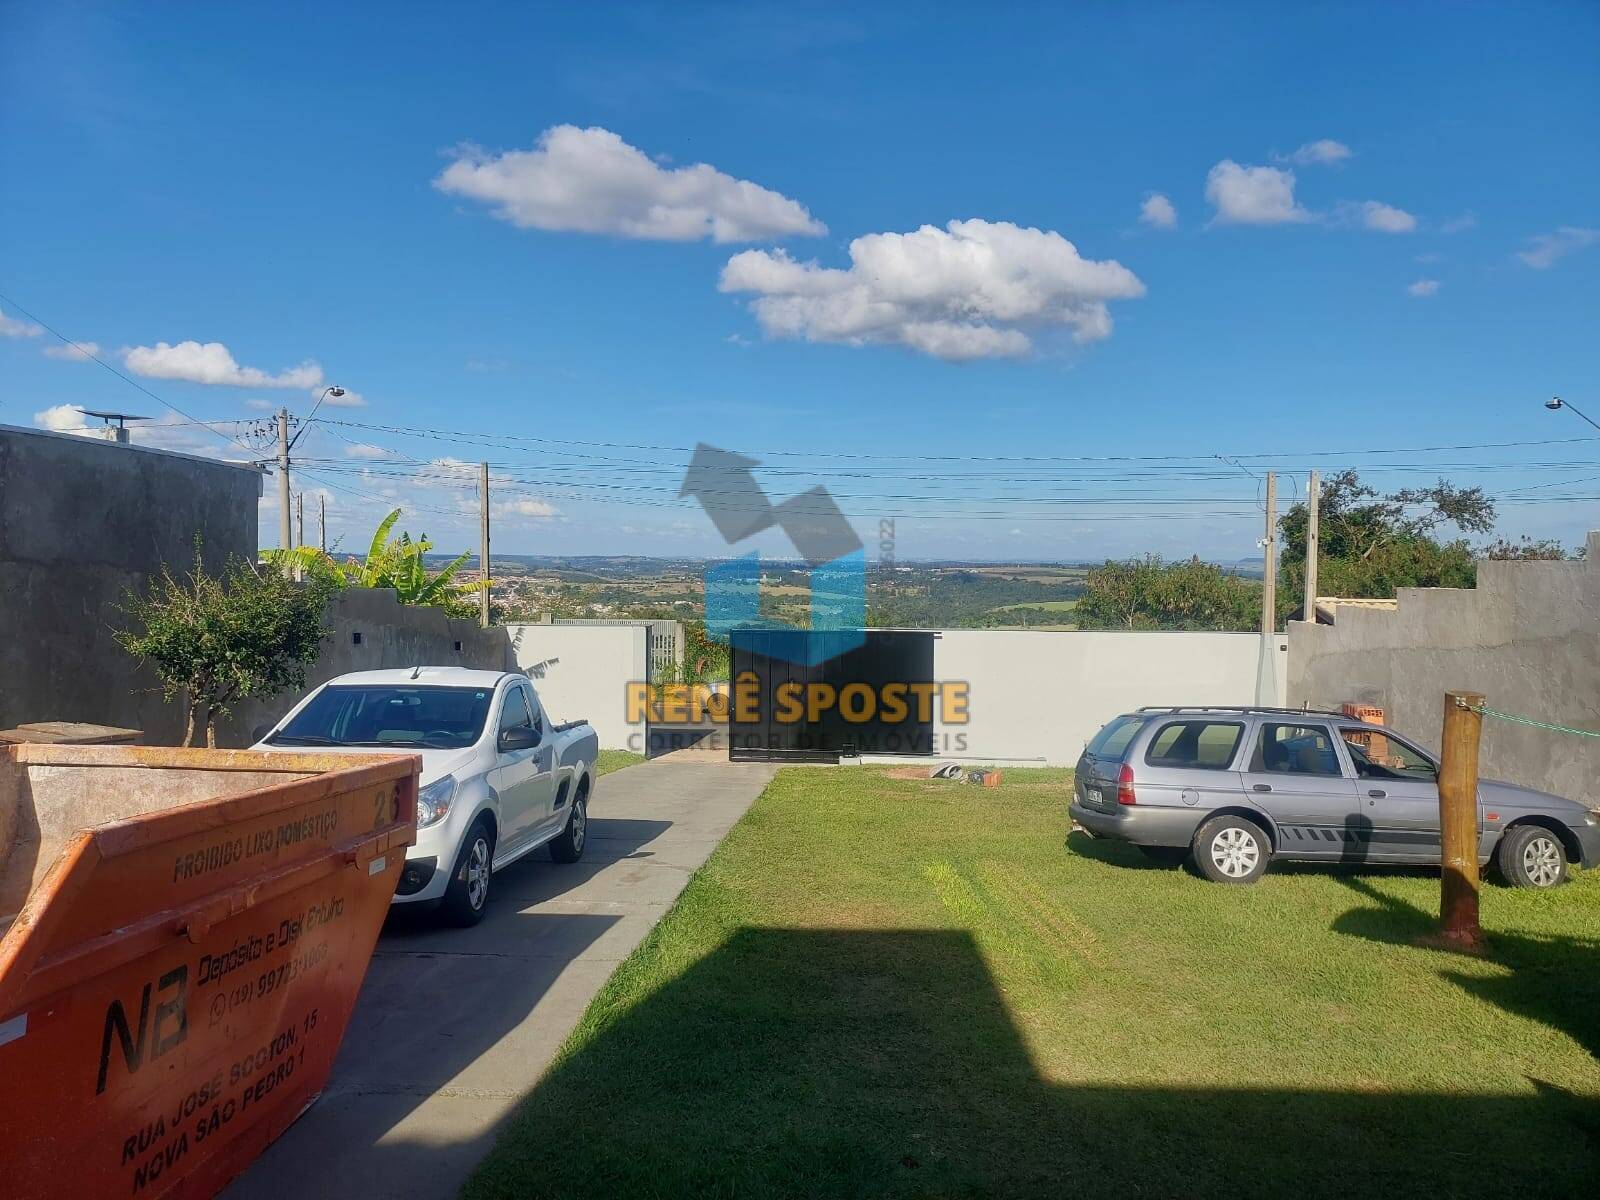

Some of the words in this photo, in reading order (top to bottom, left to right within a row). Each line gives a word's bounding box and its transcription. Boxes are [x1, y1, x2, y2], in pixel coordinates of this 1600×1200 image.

[374, 784, 400, 829] 26
[173, 841, 242, 883] PROIBIDO
[246, 828, 273, 859] LIXO
[197, 936, 263, 986] Depósito
[266, 933, 275, 954] e
[278, 914, 304, 948] Disk
[96, 963, 189, 1097] NB
[229, 981, 253, 1013] (19)
[121, 1114, 165, 1167] RUA
[172, 1068, 224, 1127] JOSÉ
[303, 1008, 319, 1037] 15
[133, 1131, 188, 1196] NOVA
[195, 1099, 236, 1142] SÃO
[242, 1056, 294, 1110] PEDRO
[299, 1045, 305, 1065] 1
